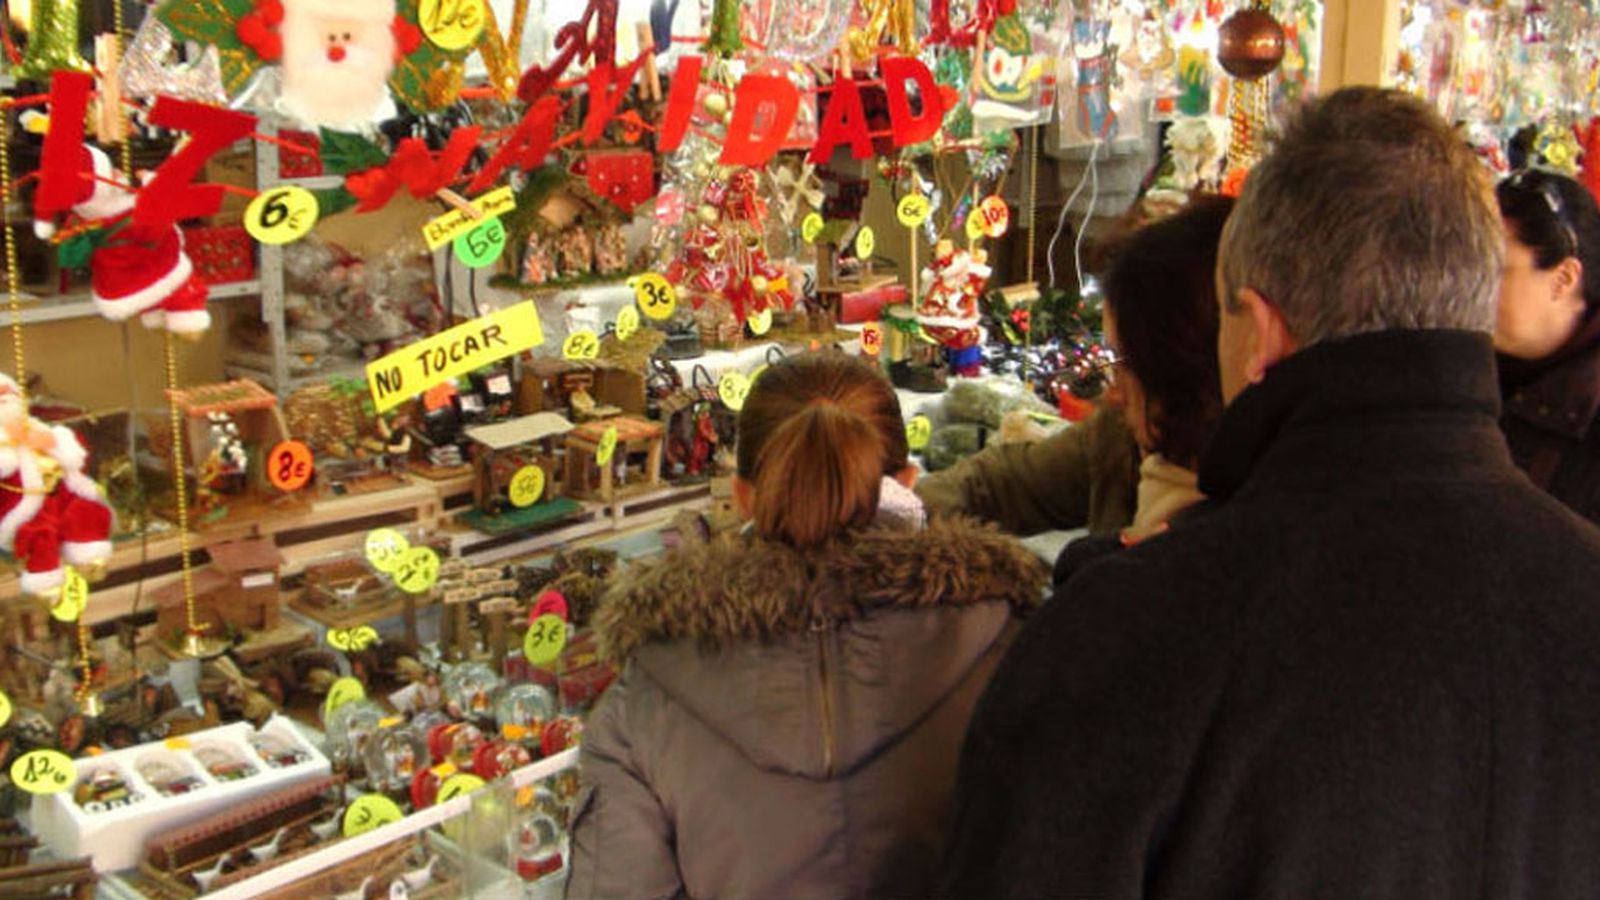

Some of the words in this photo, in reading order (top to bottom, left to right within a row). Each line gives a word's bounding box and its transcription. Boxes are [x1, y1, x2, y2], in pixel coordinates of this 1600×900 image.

[260, 191, 307, 230] 6€
[642, 281, 670, 308] 3€
[566, 334, 596, 358] 8€
[375, 366, 403, 399] NO
[416, 324, 508, 377] TOCAR
[278, 450, 306, 482] 8€
[532, 621, 562, 648] 3€
